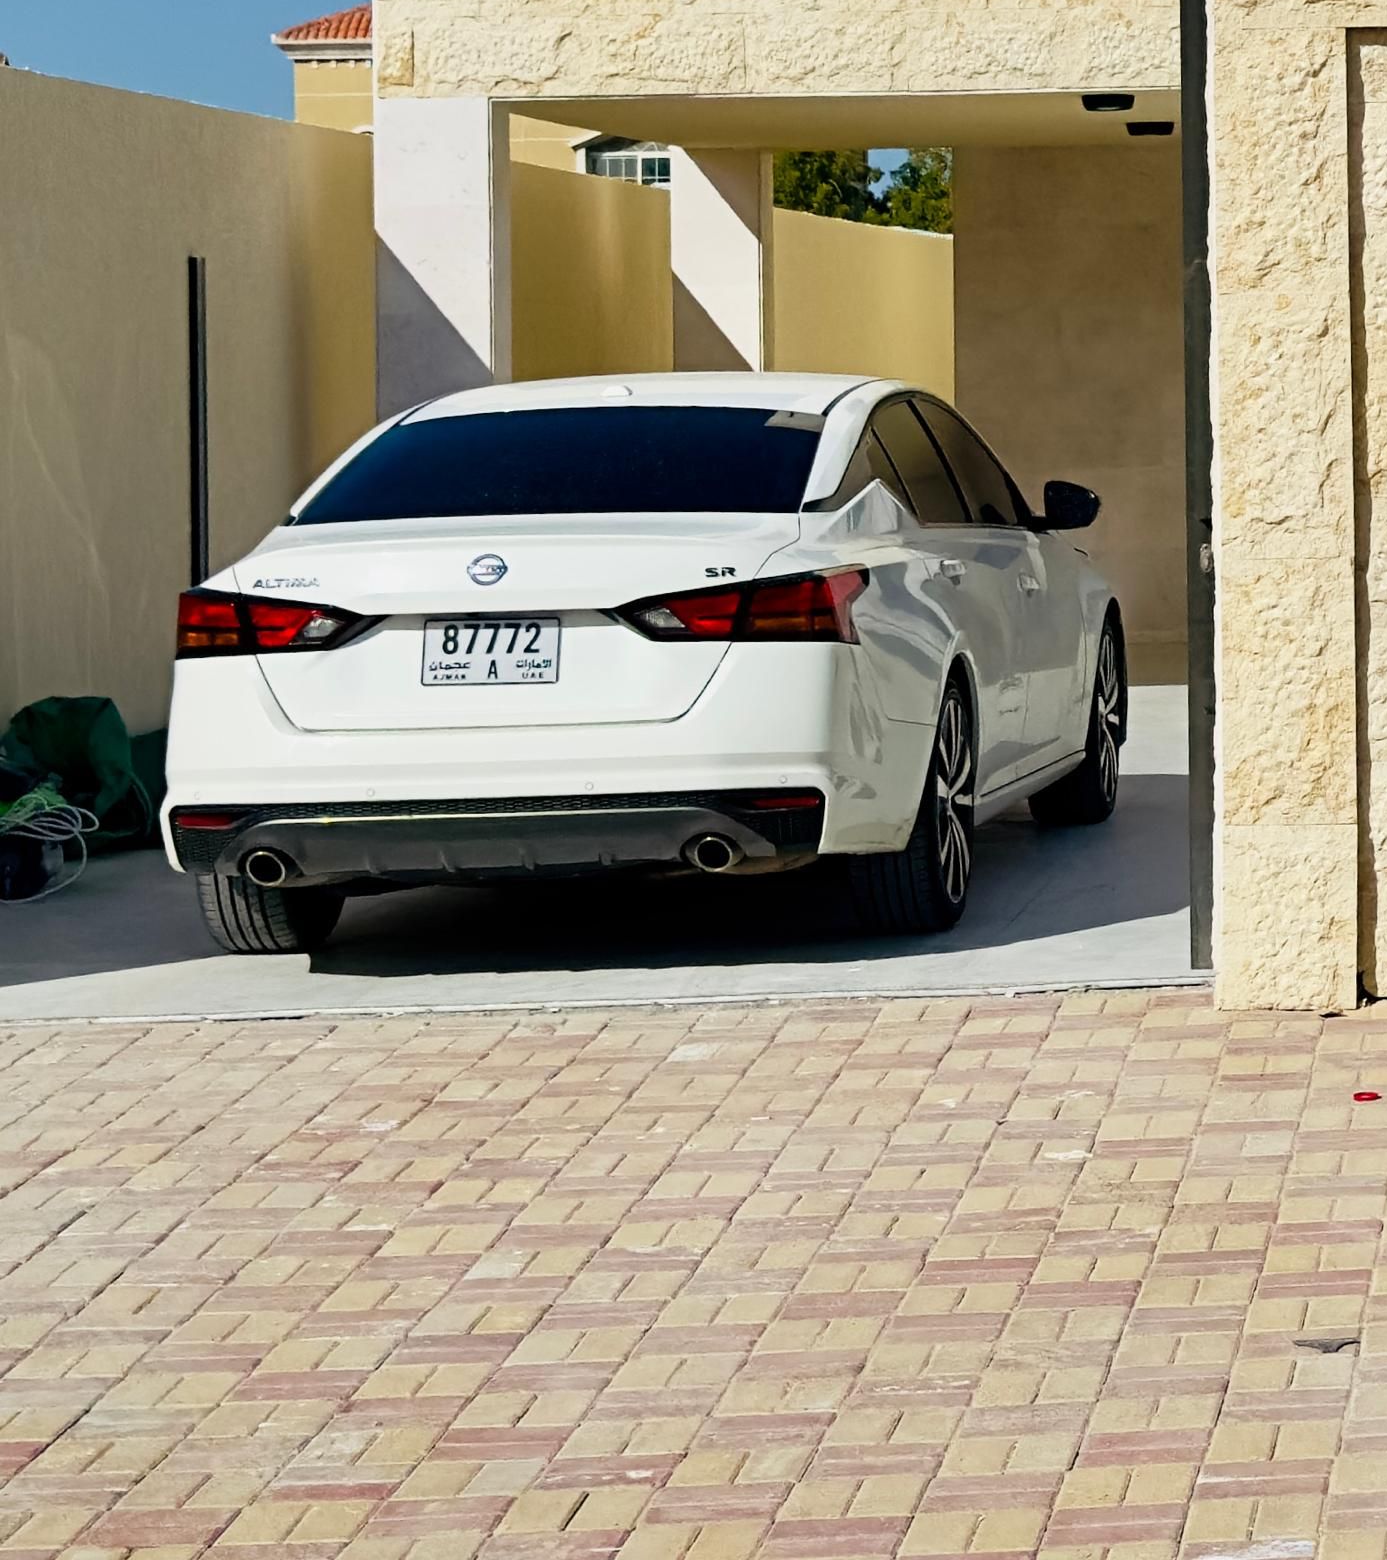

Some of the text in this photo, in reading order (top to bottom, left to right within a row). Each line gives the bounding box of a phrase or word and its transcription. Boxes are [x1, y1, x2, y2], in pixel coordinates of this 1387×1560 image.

[704, 566, 737, 578] SR
[442, 622, 542, 655] 87772
[487, 659, 499, 679] A
[521, 671, 545, 679] UAE
